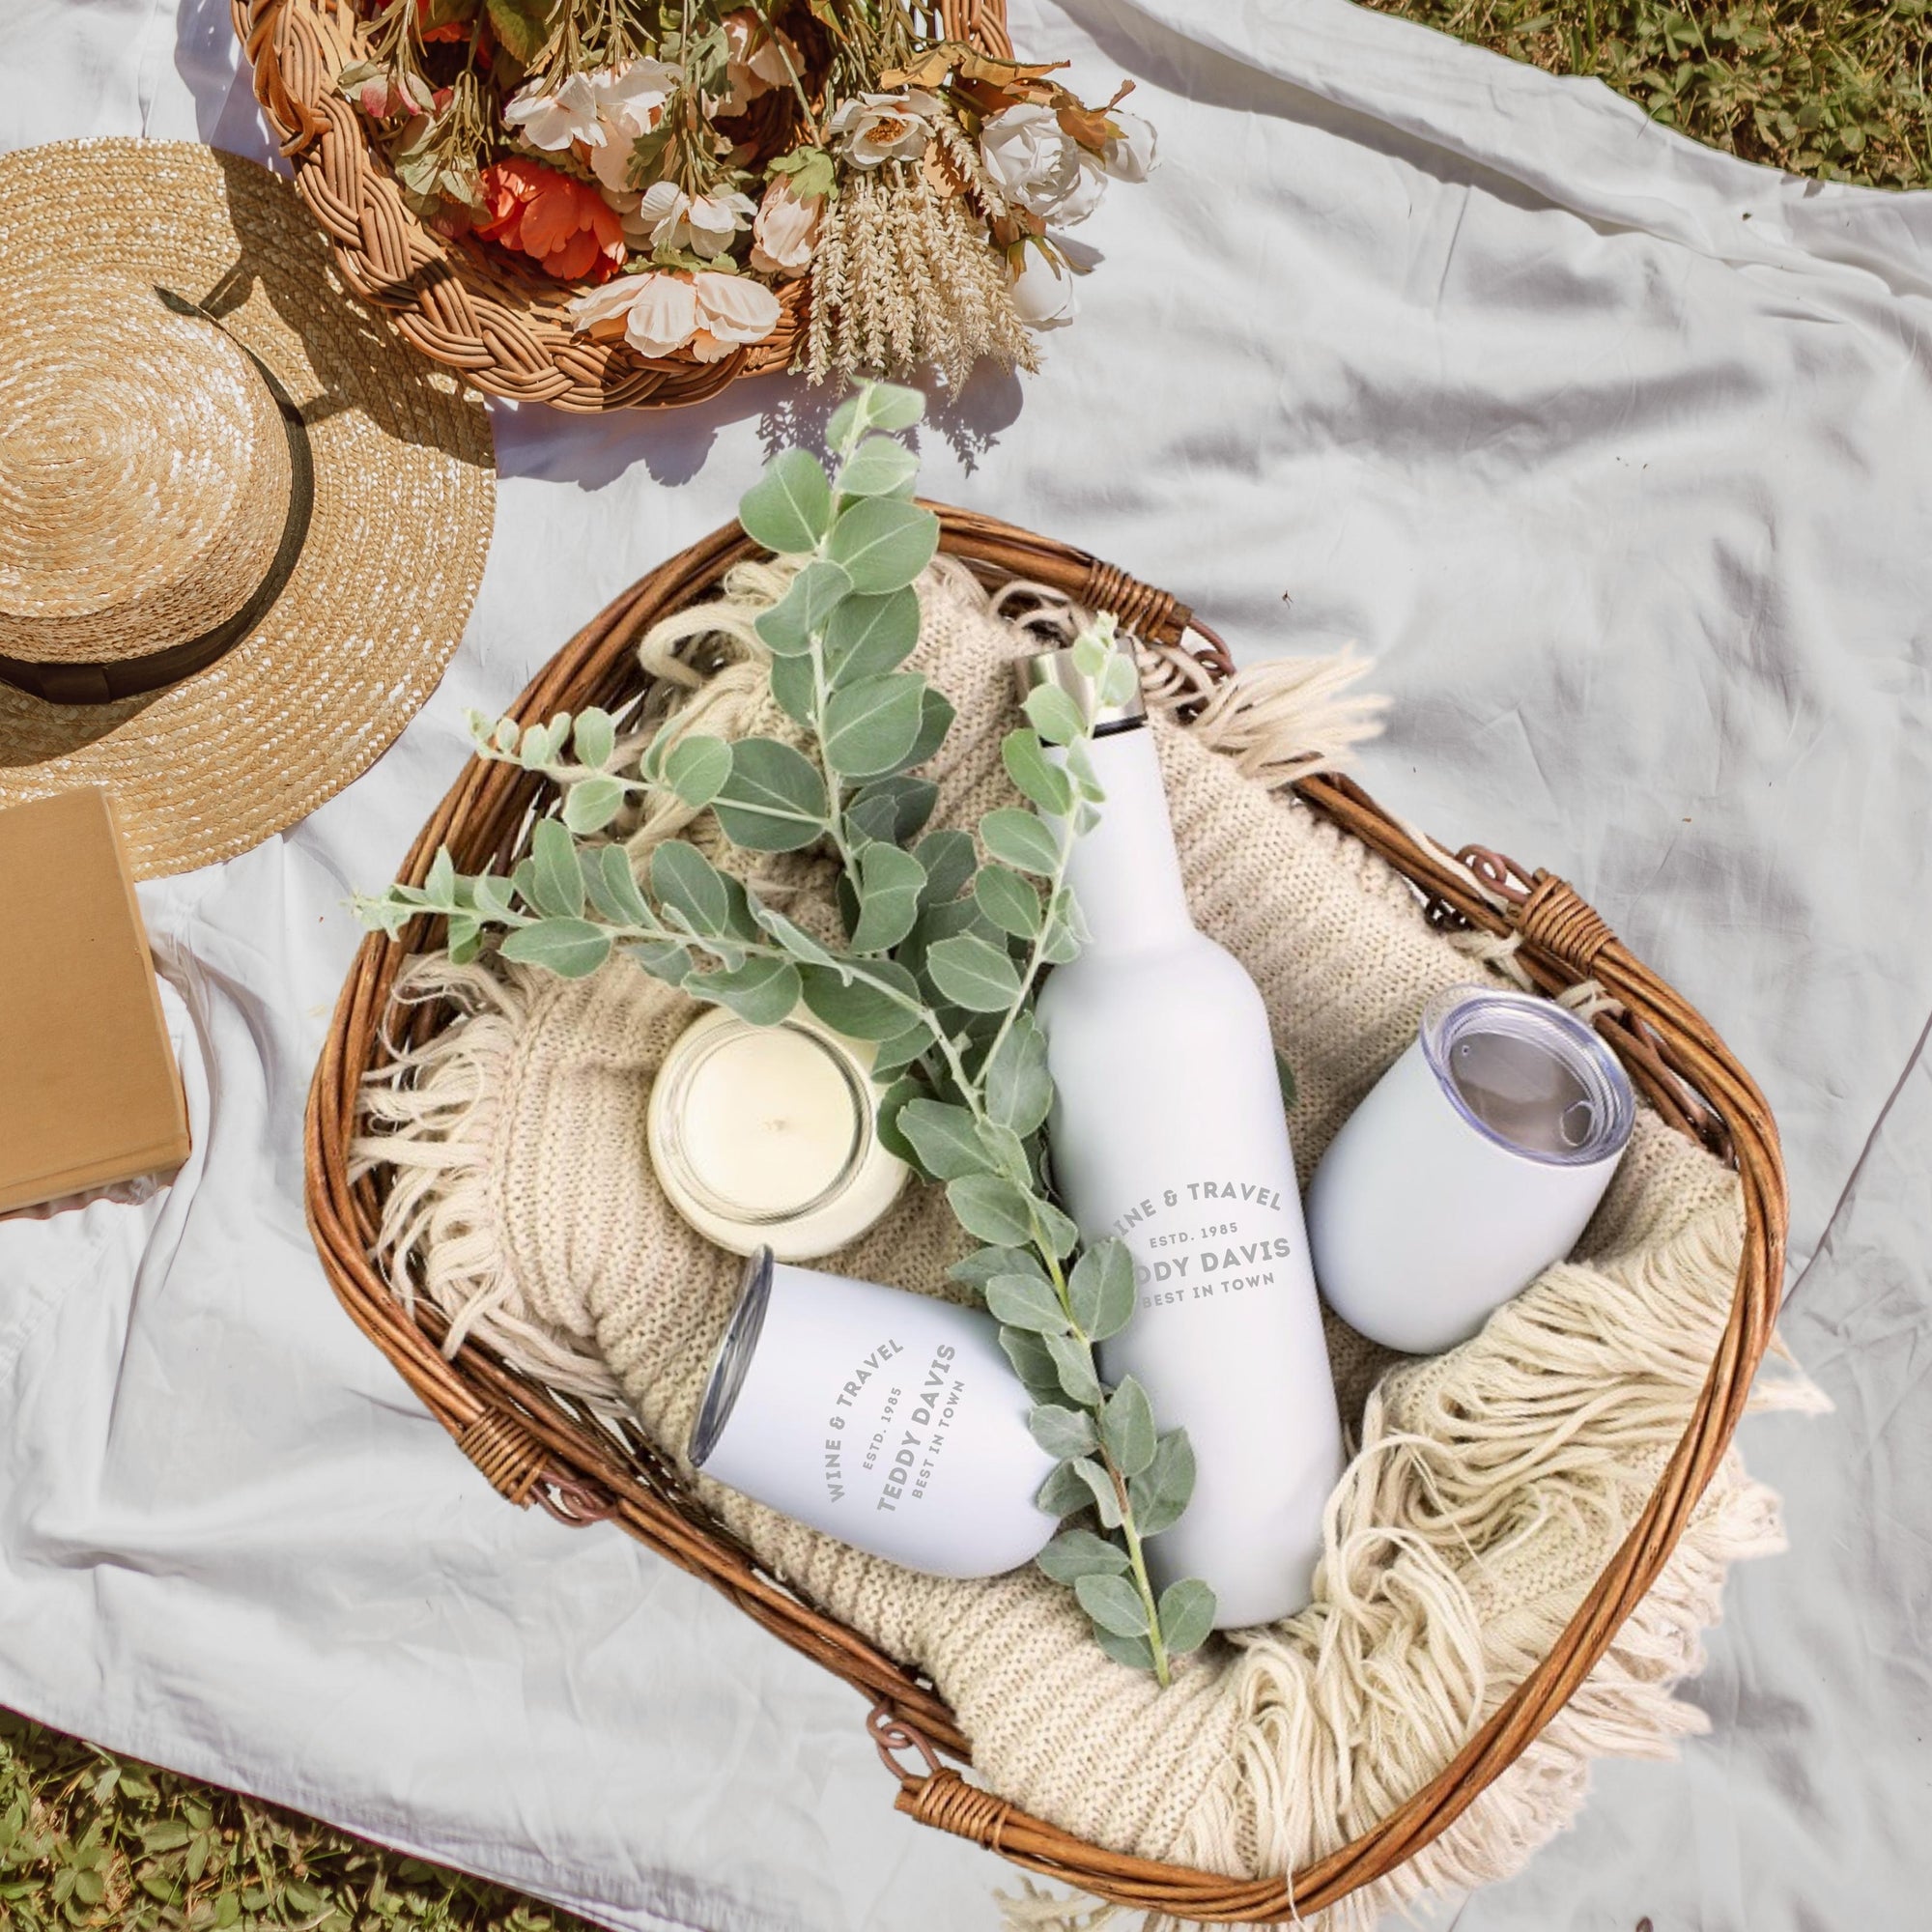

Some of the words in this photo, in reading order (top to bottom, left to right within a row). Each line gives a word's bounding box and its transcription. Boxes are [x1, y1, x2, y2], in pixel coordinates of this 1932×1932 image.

[1113, 1199, 1157, 1236] INE
[1163, 1190, 1178, 1208] &
[1186, 1181, 1282, 1211] TRAVEL
[1150, 1232, 1195, 1248] ESTD.
[1202, 1222, 1237, 1238] 1985
[1135, 1257, 1189, 1286] DDY
[1201, 1237, 1291, 1272] DAVIS
[1142, 1291, 1184, 1309] BEST
[1193, 1285, 1213, 1299] IN
[1221, 1272, 1274, 1293] TOWN
[837, 1339, 904, 1406] TRAVEL
[830, 1416, 845, 1431] &
[863, 1429, 887, 1470] ESTD.
[881, 1387, 901, 1423] 1985
[877, 1430, 921, 1511] TEDDY
[911, 1344, 955, 1426] DAVIS
[911, 1459, 934, 1499] BEST
[928, 1434, 945, 1455] IN
[938, 1380, 965, 1428] TOWN
[825, 1439, 845, 1503] WINE
